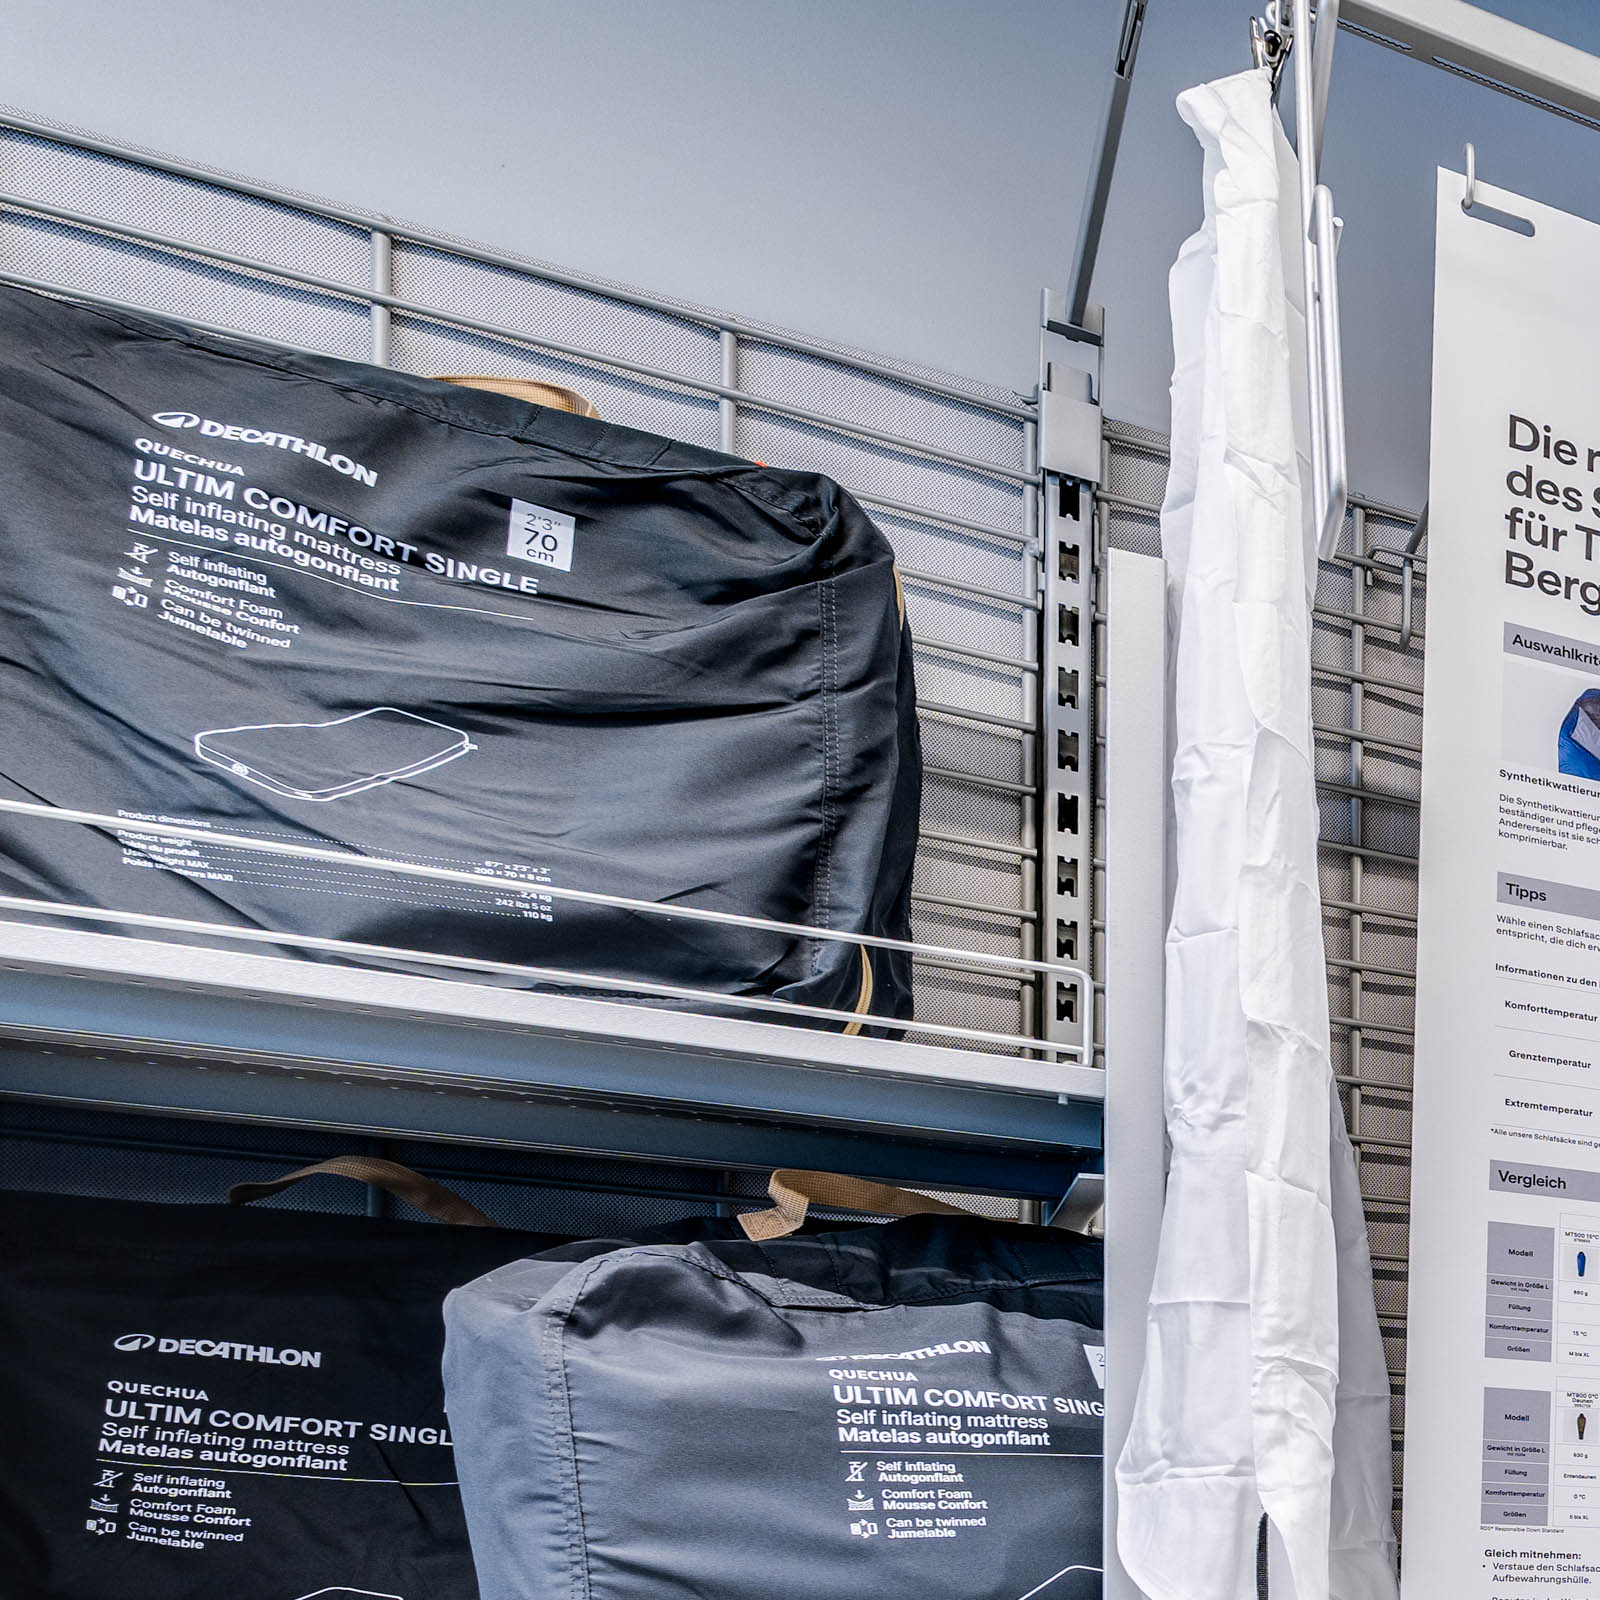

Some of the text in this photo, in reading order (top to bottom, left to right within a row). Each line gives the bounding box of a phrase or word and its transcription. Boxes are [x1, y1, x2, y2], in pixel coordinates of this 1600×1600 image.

[1509, 414, 1578, 466] Die
[134, 438, 245, 477] QUECHUA
[200, 419, 378, 488] DECATHLON
[1506, 464, 1583, 513] des
[131, 486, 400, 574] Self inflating mattress
[134, 460, 539, 595] ULTIM COMFORT SINGLE
[1505, 506, 1568, 551] für
[129, 506, 400, 592] Matelas autogonflant
[525, 531, 558, 552] 70
[526, 547, 555, 563] cm
[1506, 882, 1547, 902] Tipps
[1505, 1000, 1598, 1024] Komforttemperatur
[1509, 1049, 1591, 1069] Grenztemperatur
[1505, 1098, 1593, 1118] Extremtemperatur
[1498, 1170, 1566, 1190] Vergleich
[1508, 1249, 1533, 1258] Modell
[1508, 1303, 1531, 1312] Füllung
[1489, 1323, 1549, 1334] Komforttemperatur
[158, 1338, 321, 1368] DECATHLON
[1507, 1346, 1530, 1354] Größen
[829, 1369, 918, 1381] QUECHUA
[107, 1380, 209, 1401] QUECHUA
[832, 1385, 1104, 1416] ULTIM COMFORT SING
[104, 1399, 454, 1446] ULTIM COMFORT SINGL
[837, 1410, 1048, 1430] Self inflating mattress
[102, 1422, 349, 1455] Self inflating mattress
[838, 1428, 1050, 1448] Matelas autogonflant
[98, 1438, 348, 1472] Matelas autogonflant
[876, 1461, 956, 1474] Self inflating
[878, 1472, 964, 1484] Autogonflant
[882, 1490, 972, 1499] Comfort Foam
[883, 1500, 988, 1510] Mousse Confort
[886, 1517, 986, 1528] Can be twinned
[888, 1528, 956, 1539] Jumelable
[1484, 1549, 1581, 1561] Gleich mitnehmen:
[1492, 1562, 1532, 1572] Verstaue
[1534, 1563, 1554, 1572] den
[1492, 1574, 1591, 1586] Aufbewahrungshülle.
